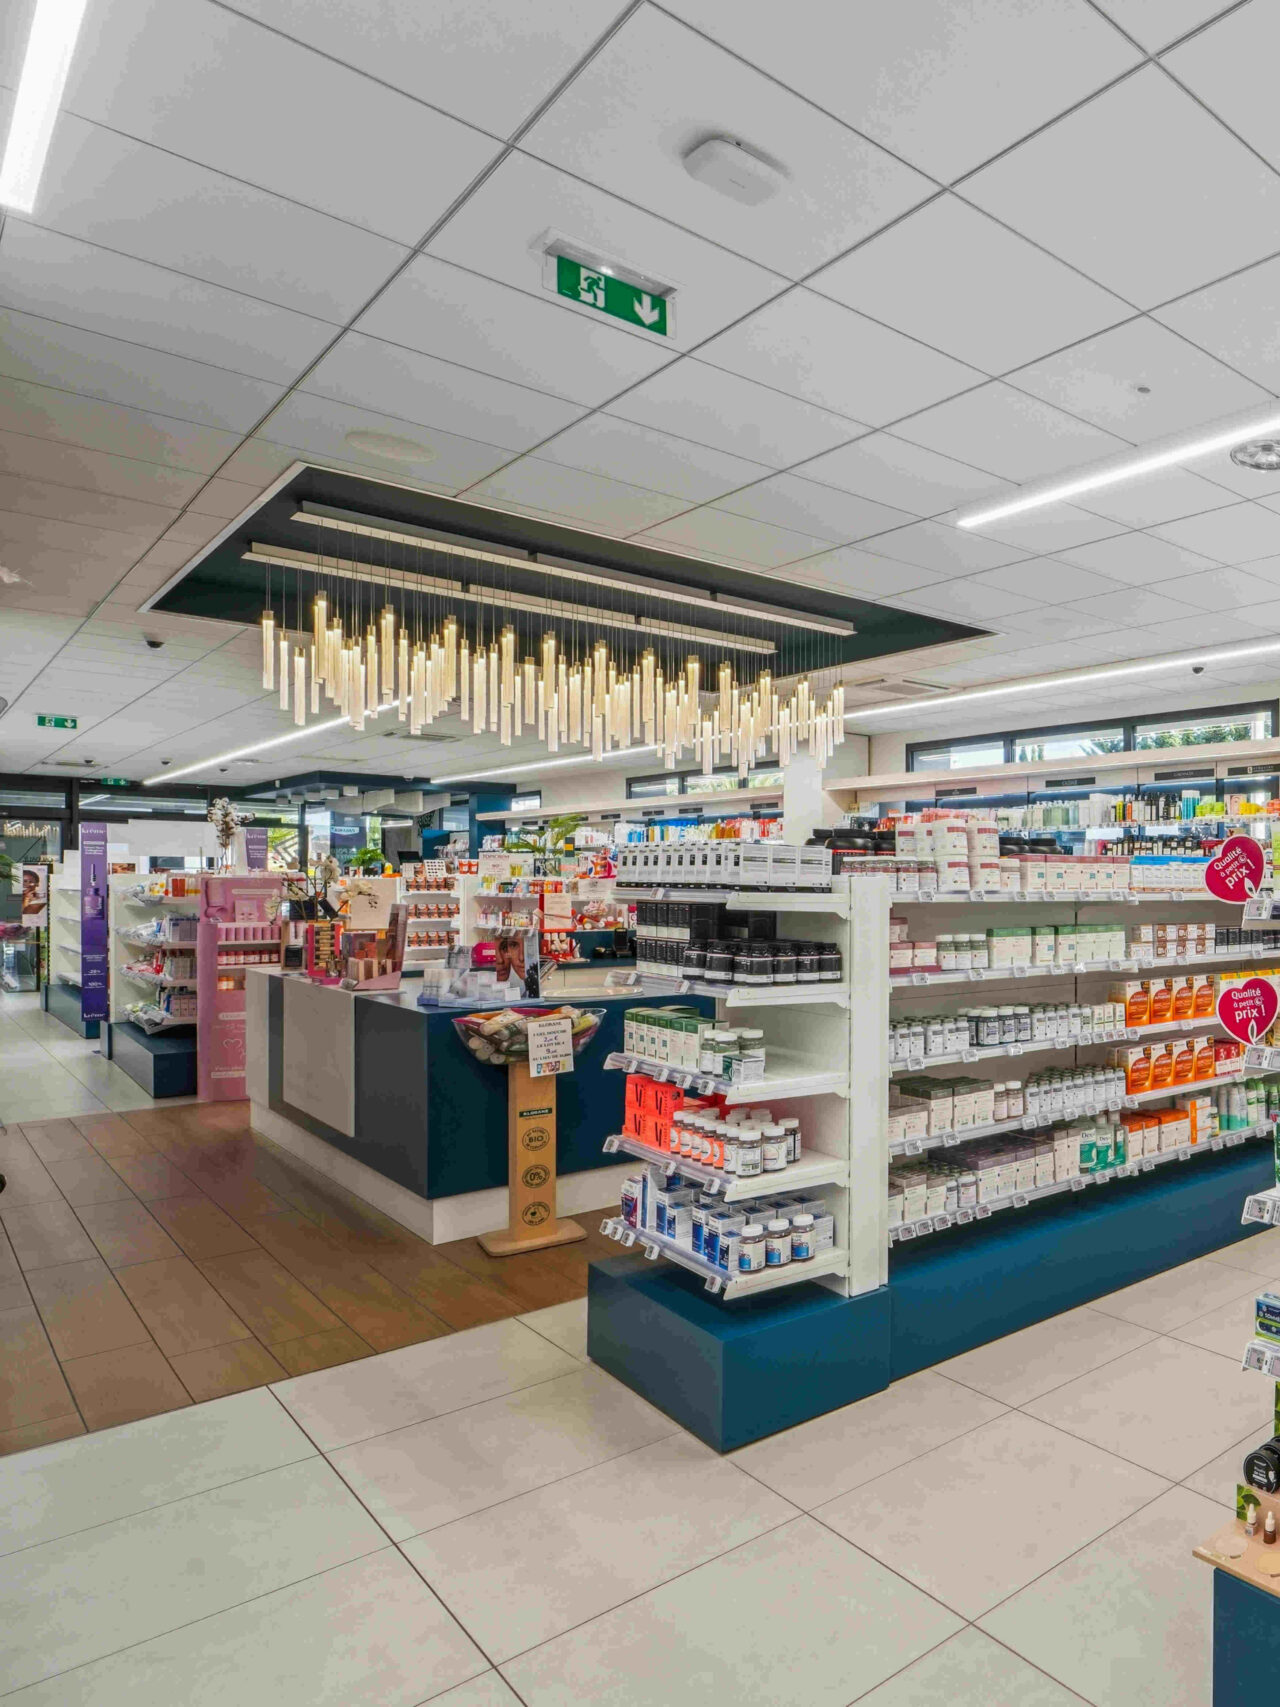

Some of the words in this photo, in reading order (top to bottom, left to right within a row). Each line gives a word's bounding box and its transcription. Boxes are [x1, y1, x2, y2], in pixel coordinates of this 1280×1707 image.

[1213, 846, 1243, 871] Qualité
[1225, 860, 1240, 876] petit
[1225, 866, 1249, 889] prix
[1231, 987, 1262, 999] Qualité
[1239, 999, 1255, 1009] petit
[1235, 1007, 1259, 1023] prix
[528, 1135, 544, 1143] BIO
